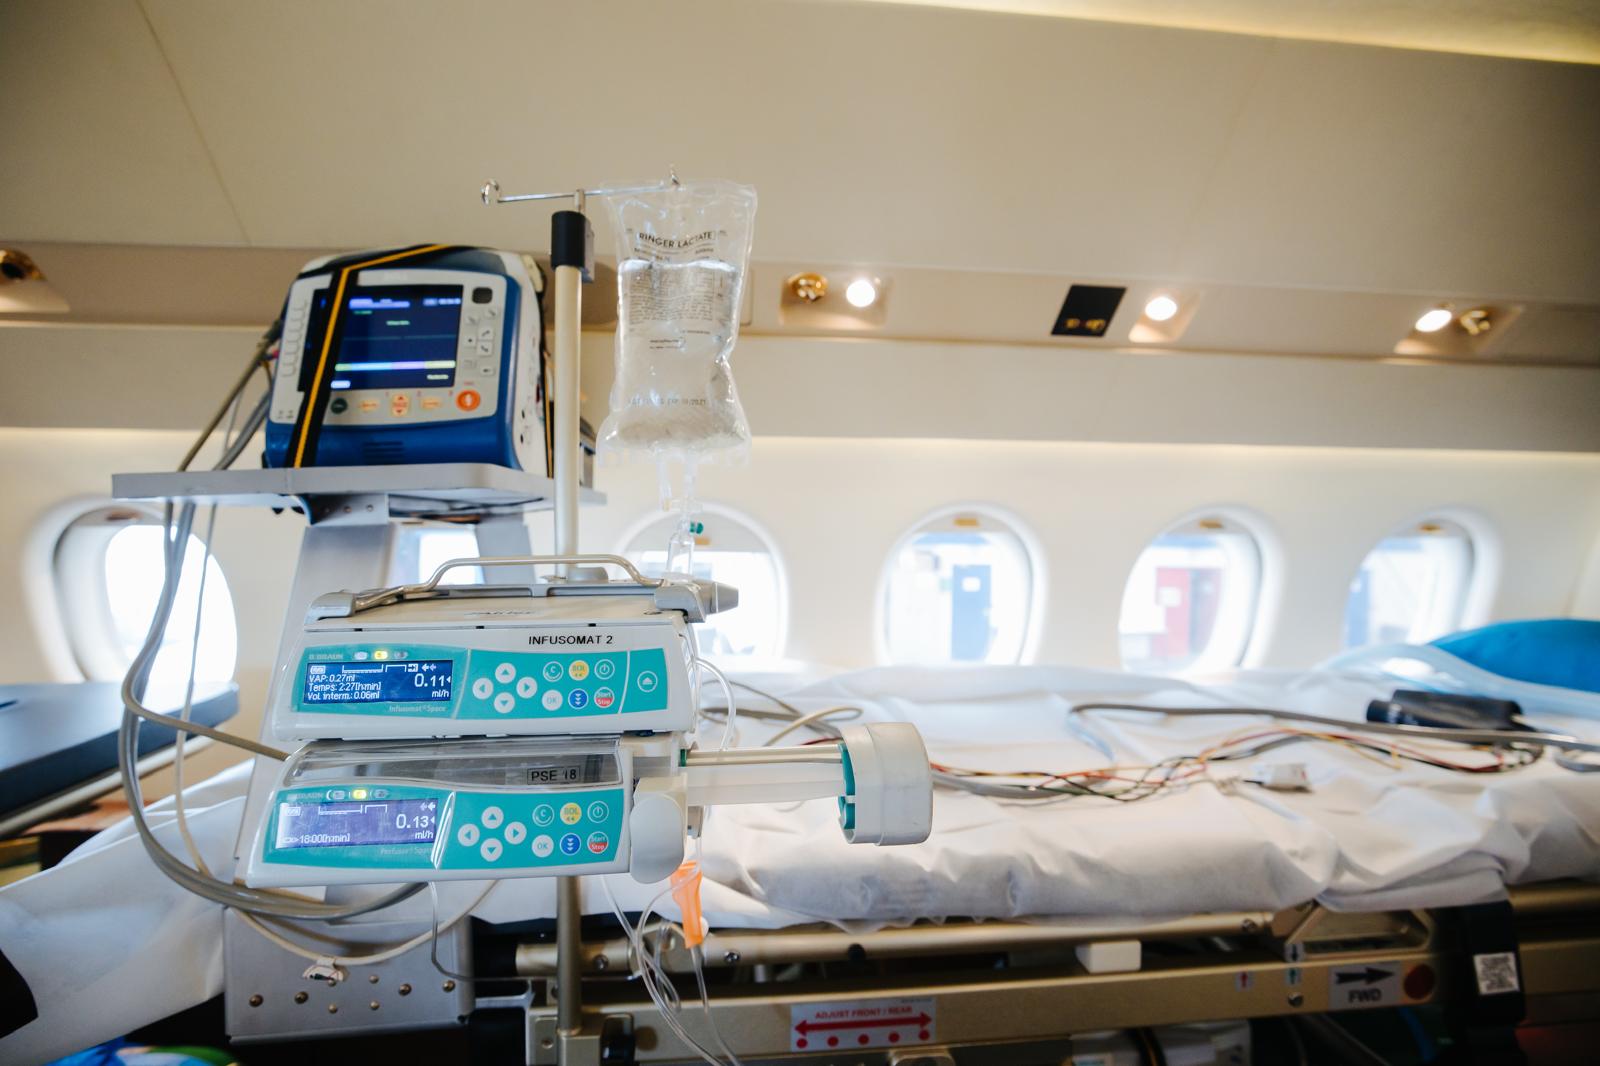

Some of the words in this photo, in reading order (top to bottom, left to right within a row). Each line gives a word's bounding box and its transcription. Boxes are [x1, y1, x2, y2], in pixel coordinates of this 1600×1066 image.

[639, 231, 676, 249] RINGER
[677, 231, 713, 248] LACTATE
[528, 635, 602, 645] INFUSOMAT
[606, 635, 613, 644] 2
[308, 674, 329, 683] VAP:
[330, 674, 355, 682] 0.27ml
[414, 673, 445, 687] 0.11
[308, 683, 337, 692] Temps:
[354, 690, 380, 700] 0.06ml
[431, 690, 450, 698] ml/h
[531, 770, 558, 782] PSE
[541, 809, 546, 817] C
[396, 813, 429, 829] 0.13
[415, 830, 433, 839] ml/h
[536, 842, 548, 850] OK
[1350, 989, 1382, 1003] FWD
[815, 1009, 850, 1020] ADJUST
[851, 1007, 881, 1018] FRONT
